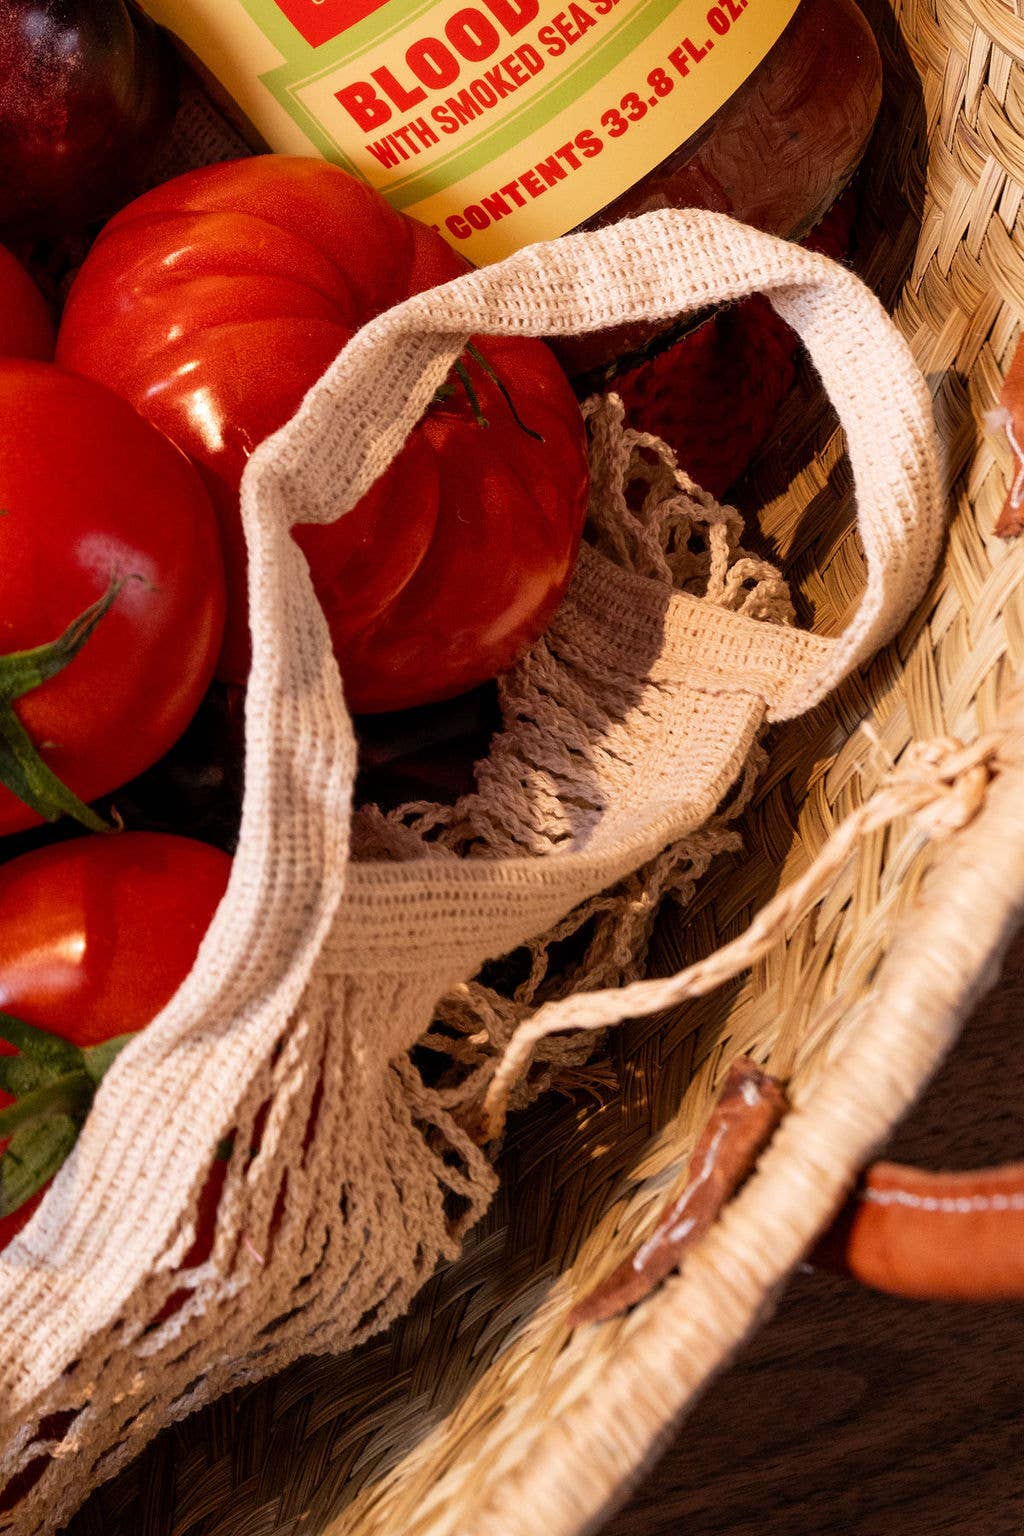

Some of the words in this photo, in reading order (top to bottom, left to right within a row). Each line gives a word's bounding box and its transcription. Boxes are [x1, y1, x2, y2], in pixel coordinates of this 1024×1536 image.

[364, 116, 440, 170] WITH
[430, 42, 545, 135] SMOKED
[537, 2, 597, 57] SEA
[445, 129, 605, 240] CONTENTS
[600, 67, 675, 139] 33.8
[667, 33, 716, 79] FL.
